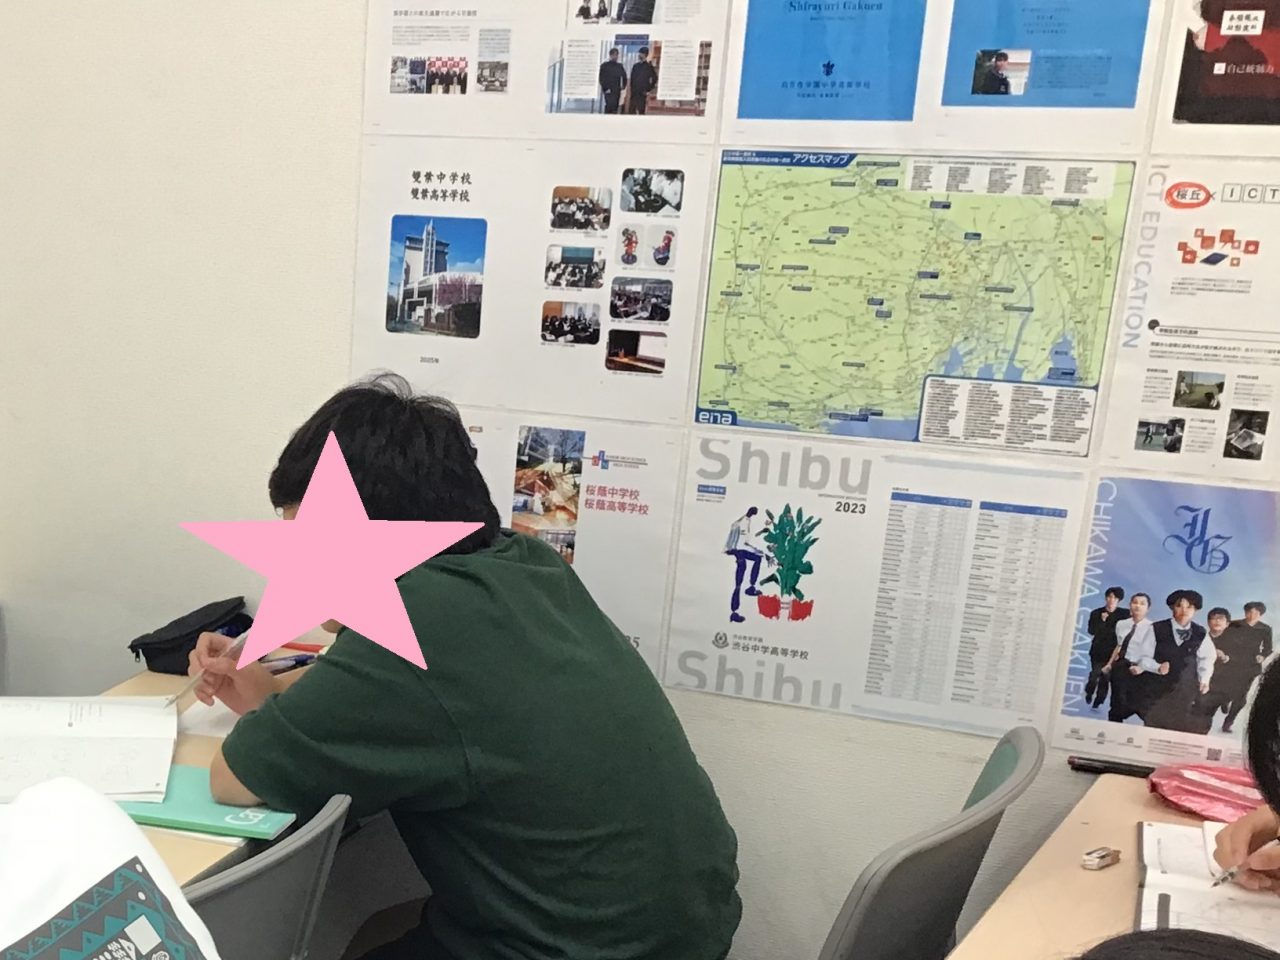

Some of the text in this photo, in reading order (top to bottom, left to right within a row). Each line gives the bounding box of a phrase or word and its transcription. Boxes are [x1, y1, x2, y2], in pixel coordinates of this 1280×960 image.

[792, 153, 849, 165] アクセスマップ
[1122, 211, 1160, 348] EDUCATION
[698, 410, 732, 424] ena
[696, 437, 872, 495] Shibu
[834, 500, 867, 515] 2023
[732, 641, 809, 660] 渋谷中学高等学校
[1061, 607, 1094, 713] GAKUEN
[674, 650, 843, 709] Shibu
